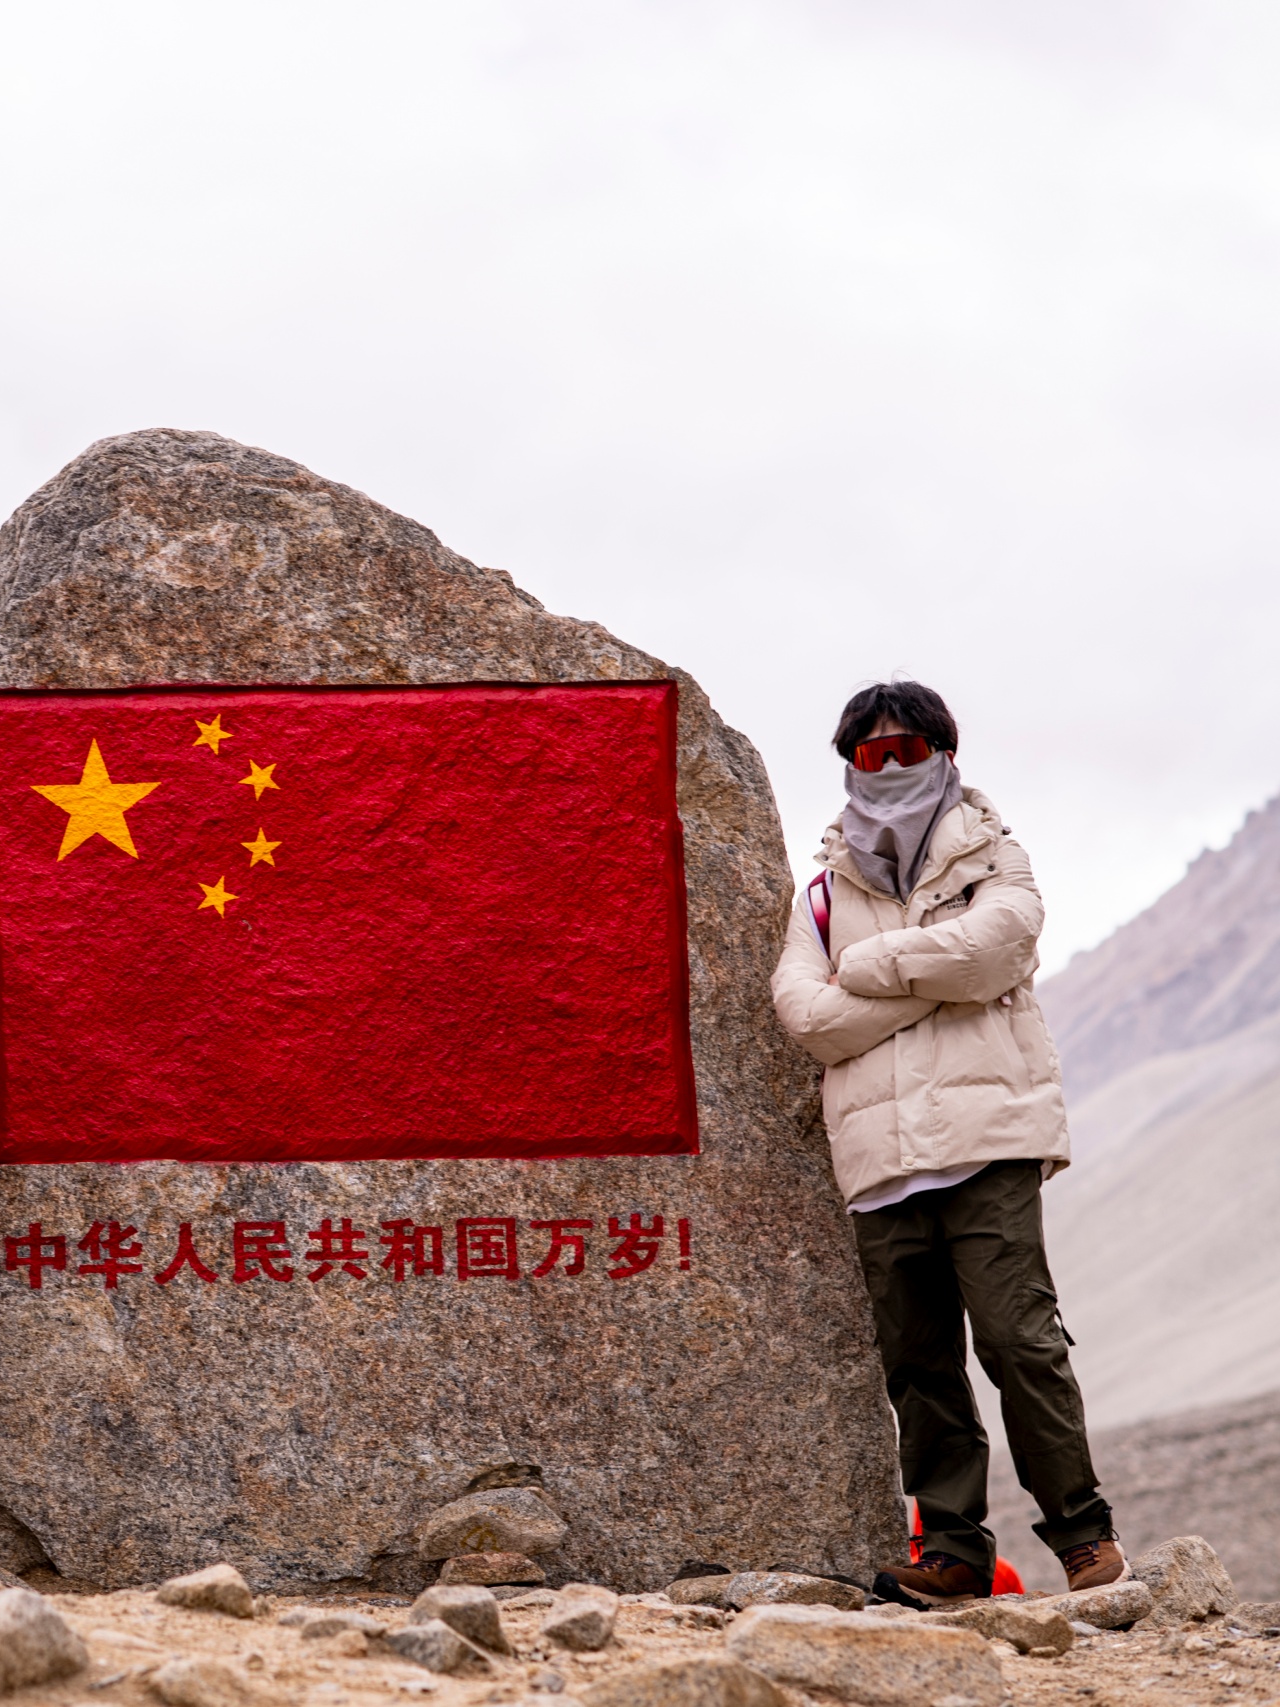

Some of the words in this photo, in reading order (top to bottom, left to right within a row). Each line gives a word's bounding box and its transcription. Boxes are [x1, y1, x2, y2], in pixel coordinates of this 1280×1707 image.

[4, 1213, 691, 1290] 中华人民共和国万岁!
